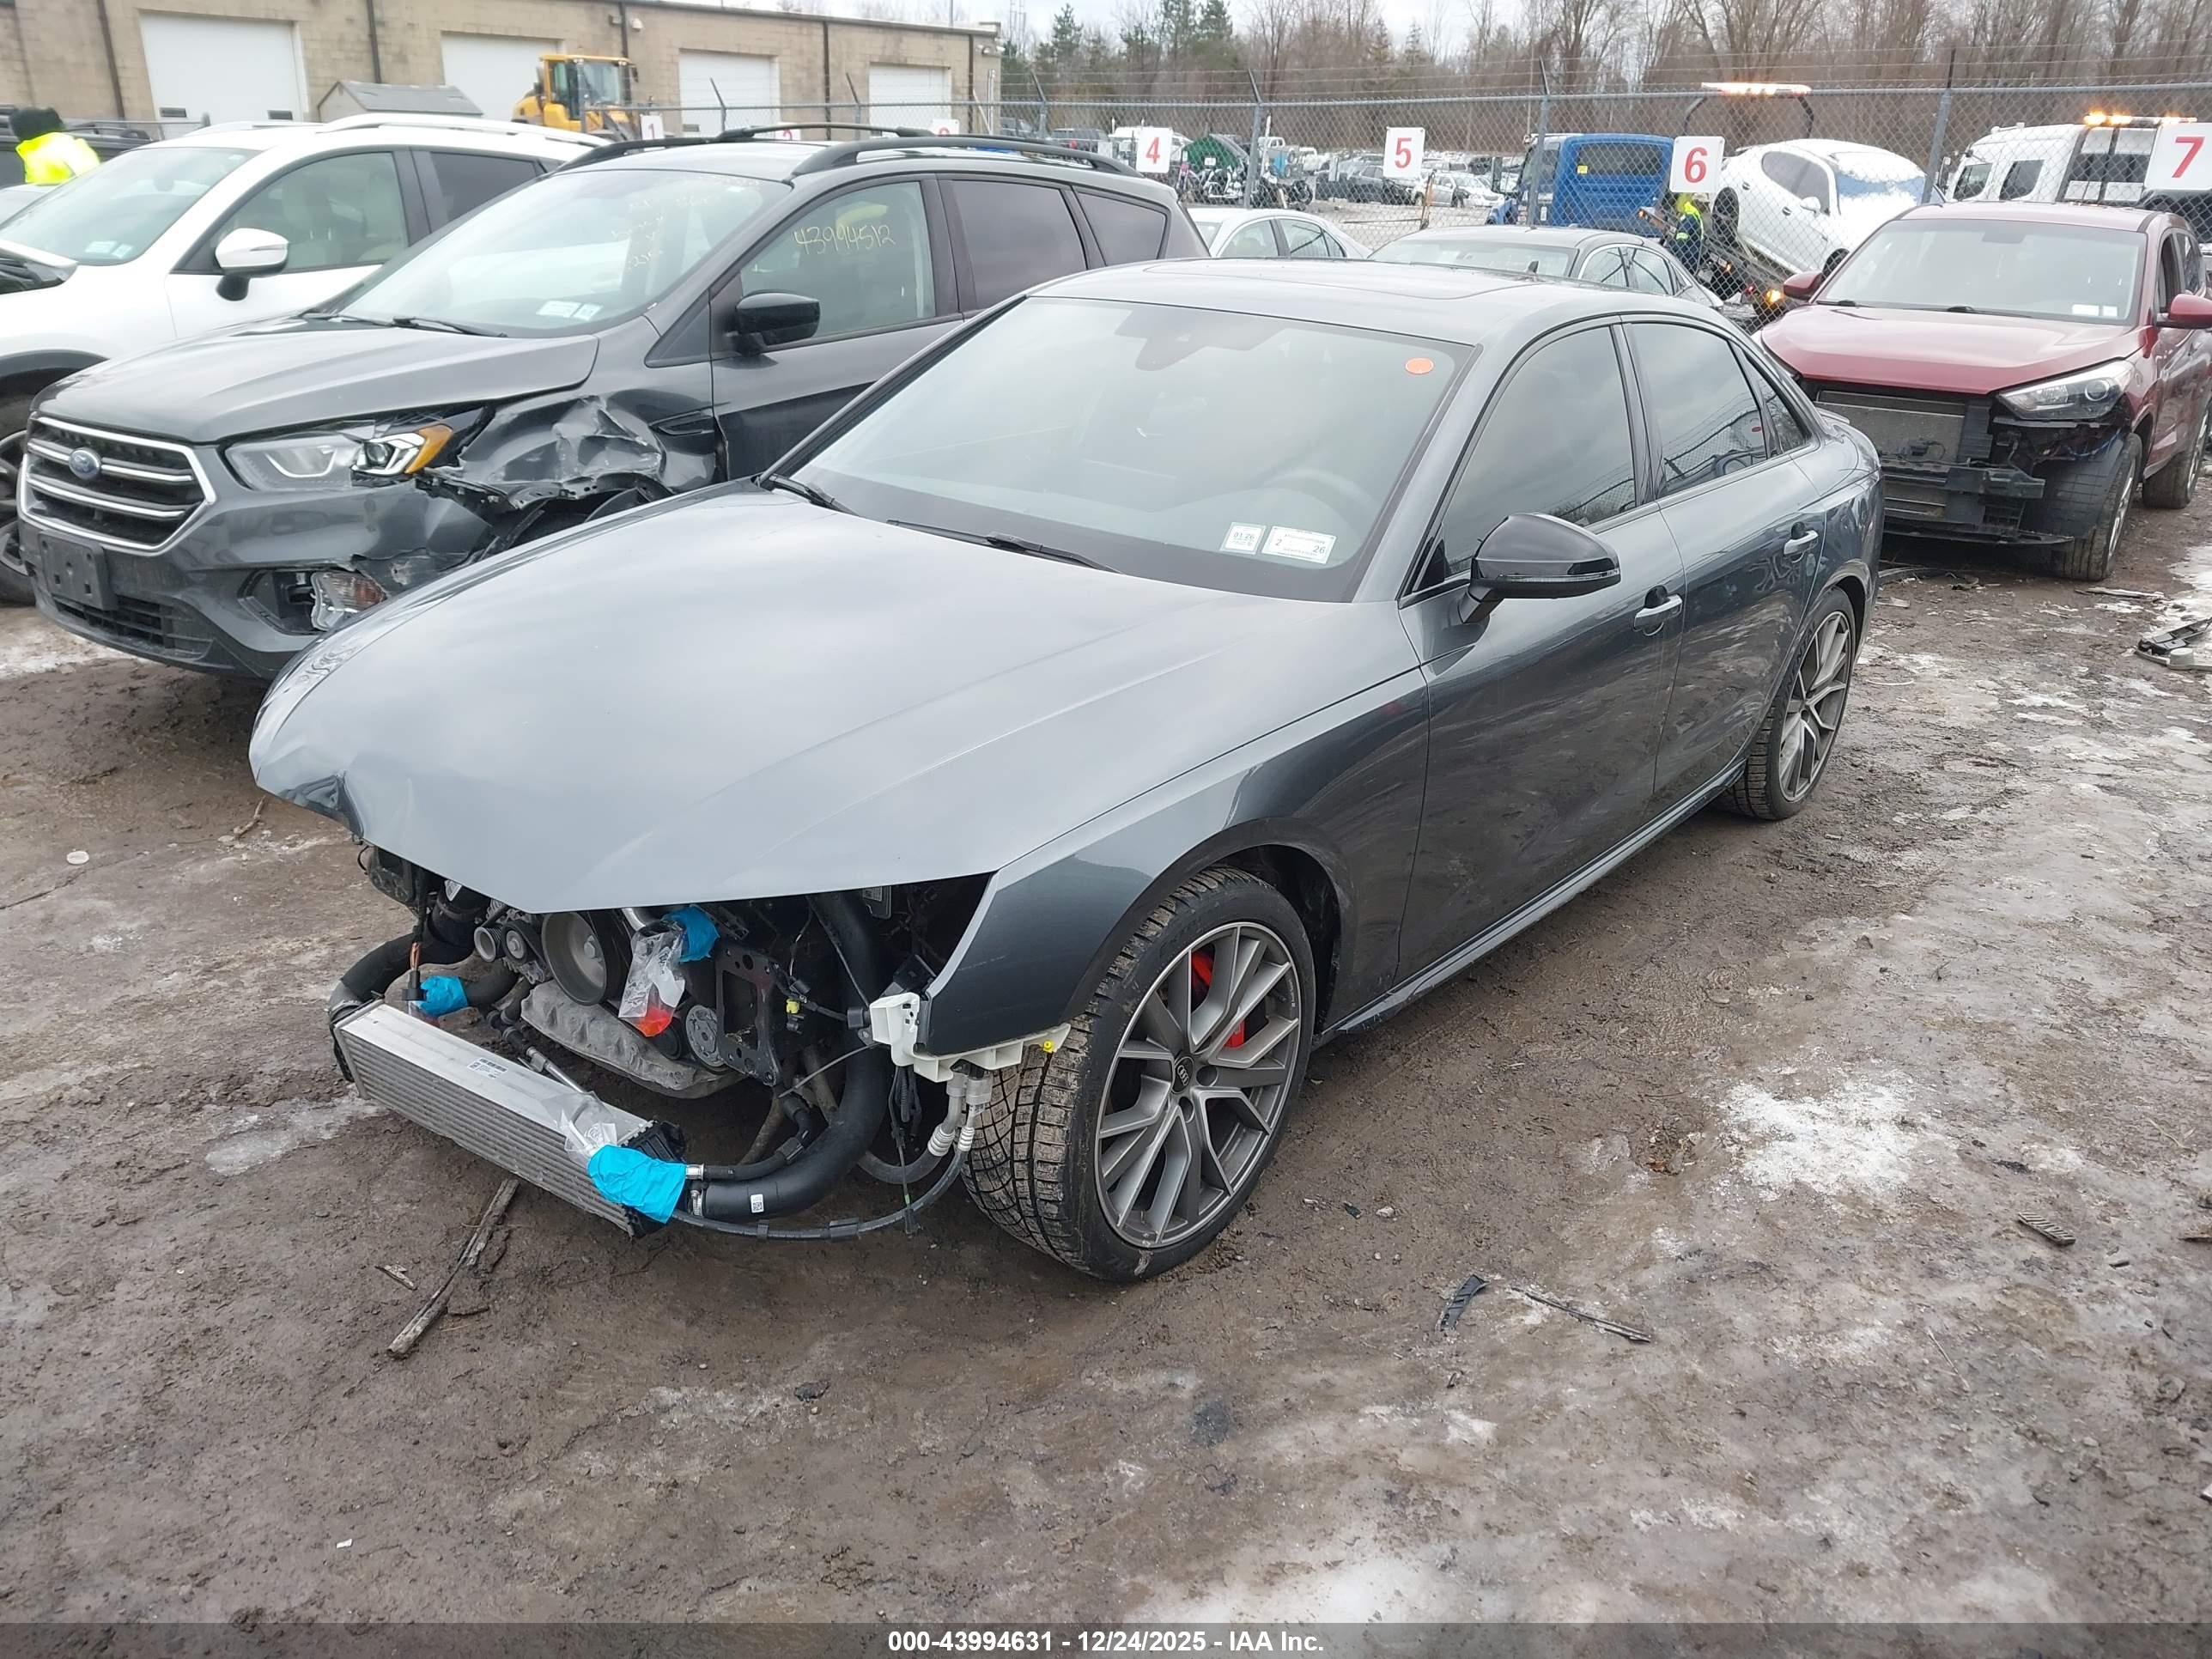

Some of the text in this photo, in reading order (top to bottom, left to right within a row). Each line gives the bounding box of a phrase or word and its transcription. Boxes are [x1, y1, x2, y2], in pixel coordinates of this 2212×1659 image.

[1146, 137, 1161, 164] 4
[1394, 137, 1413, 169] 5
[1684, 147, 1708, 184] 6
[2172, 136, 2206, 179] 7
[793, 224, 896, 255] 43994512
[1312, 544, 1327, 556] 26
